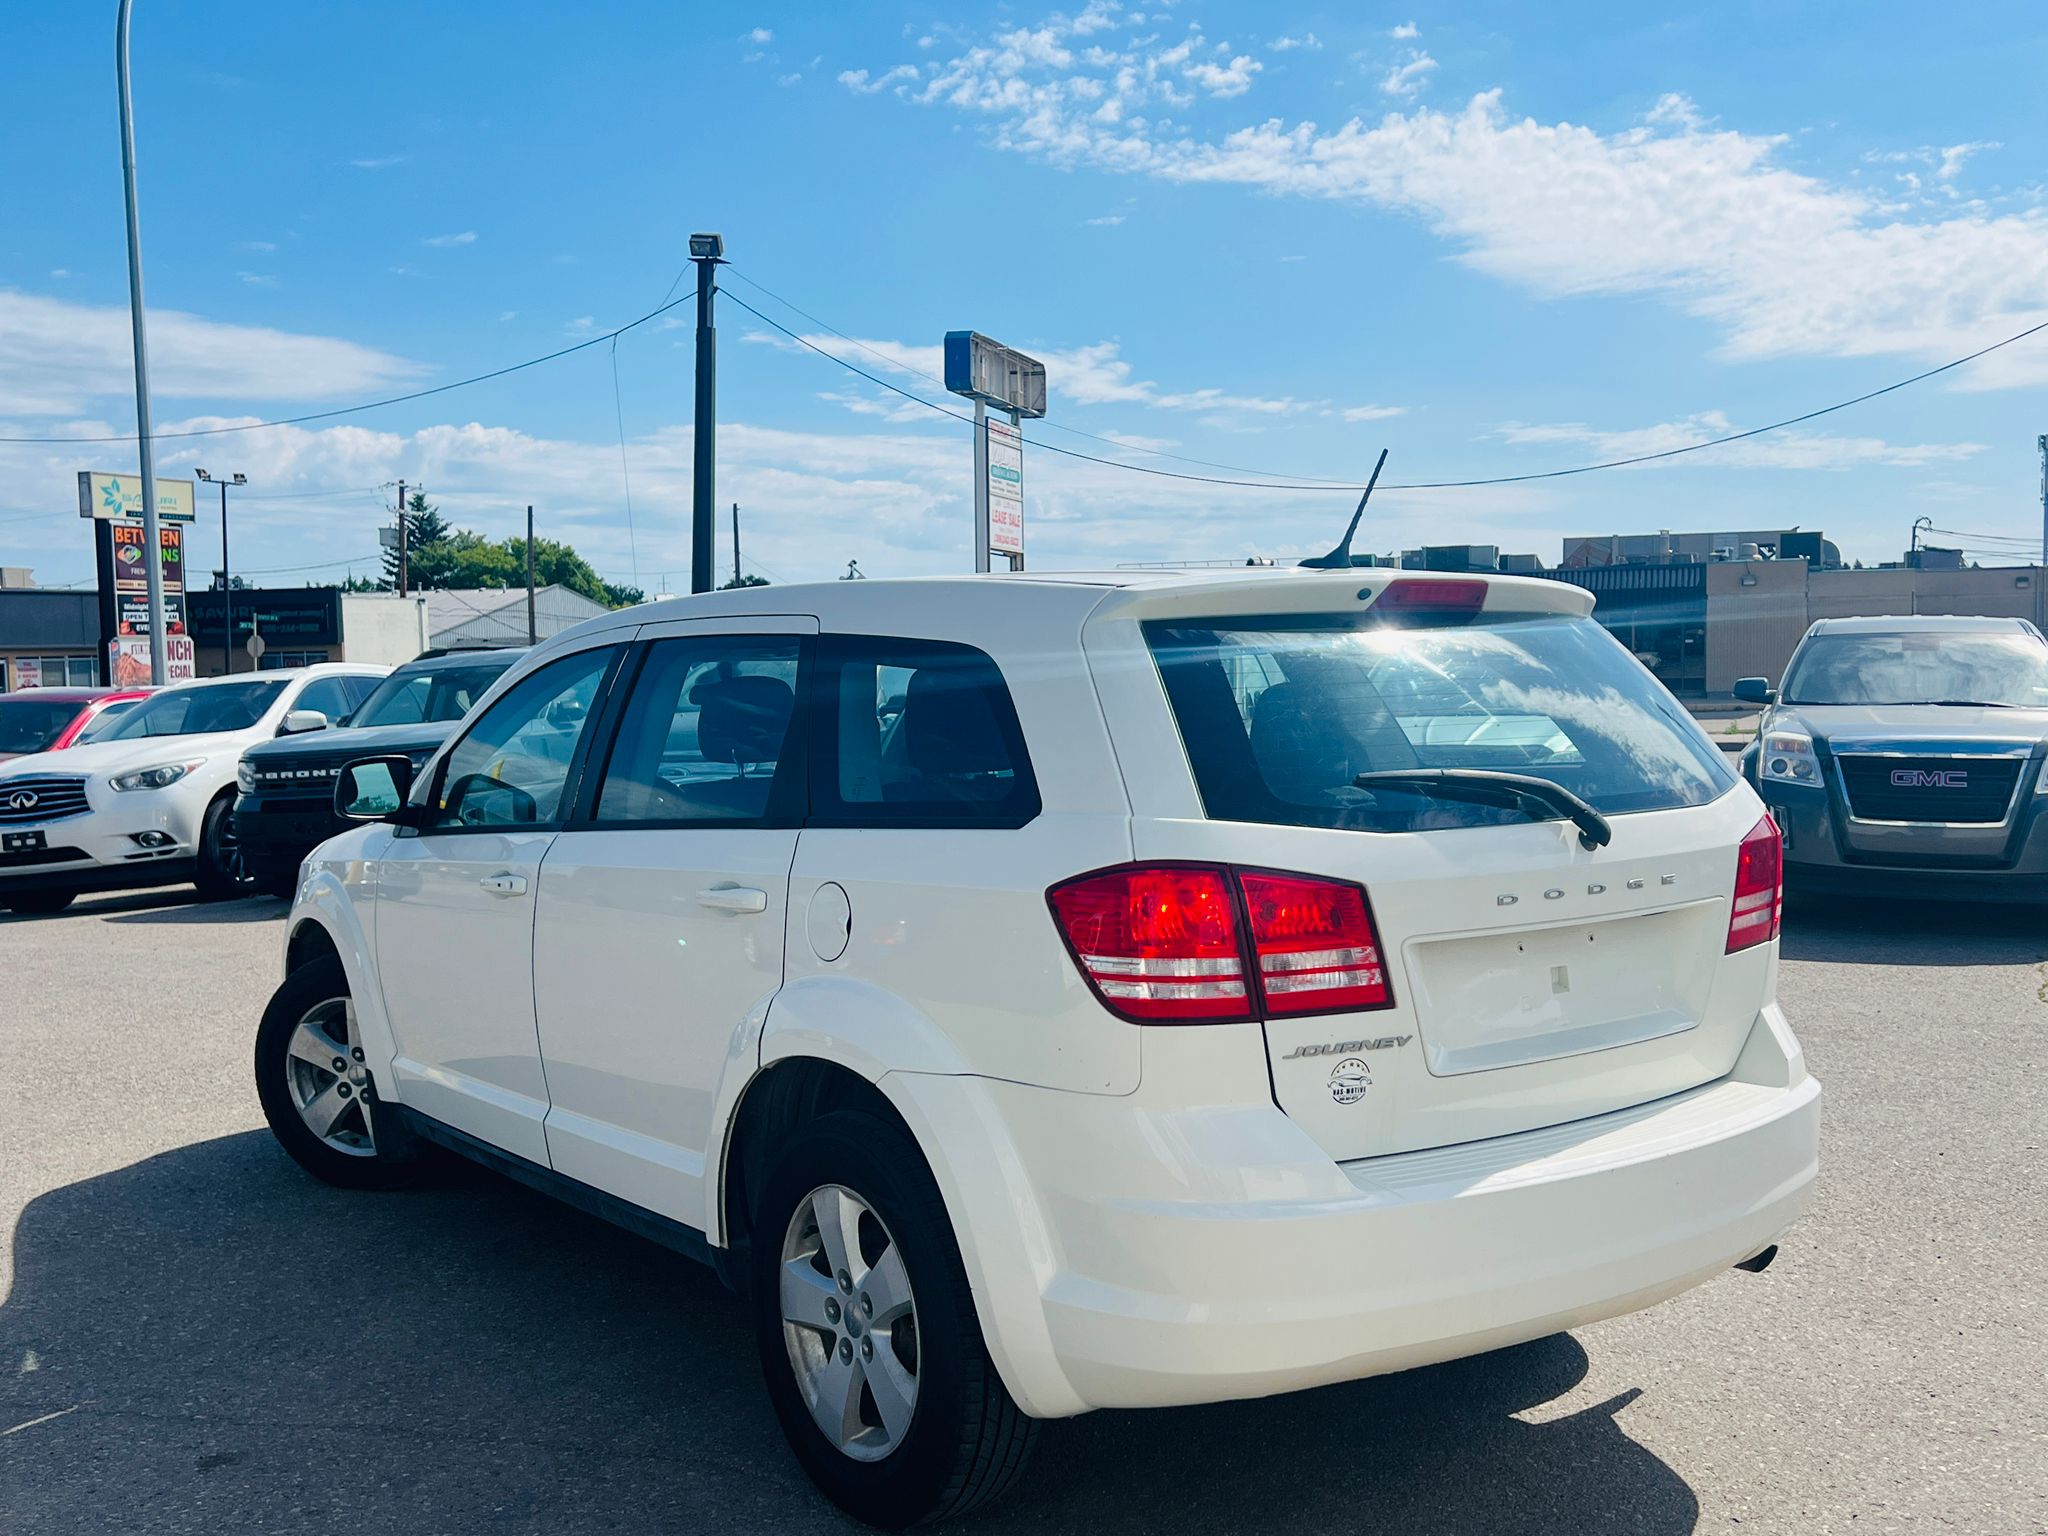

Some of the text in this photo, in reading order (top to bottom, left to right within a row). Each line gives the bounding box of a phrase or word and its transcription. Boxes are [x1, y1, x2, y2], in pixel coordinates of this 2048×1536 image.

[115, 527, 179, 546] BETEN
[1891, 769, 1967, 787] GMC
[1497, 873, 1676, 906] DODGE
[1282, 1035, 1413, 1060] JOURNEY
